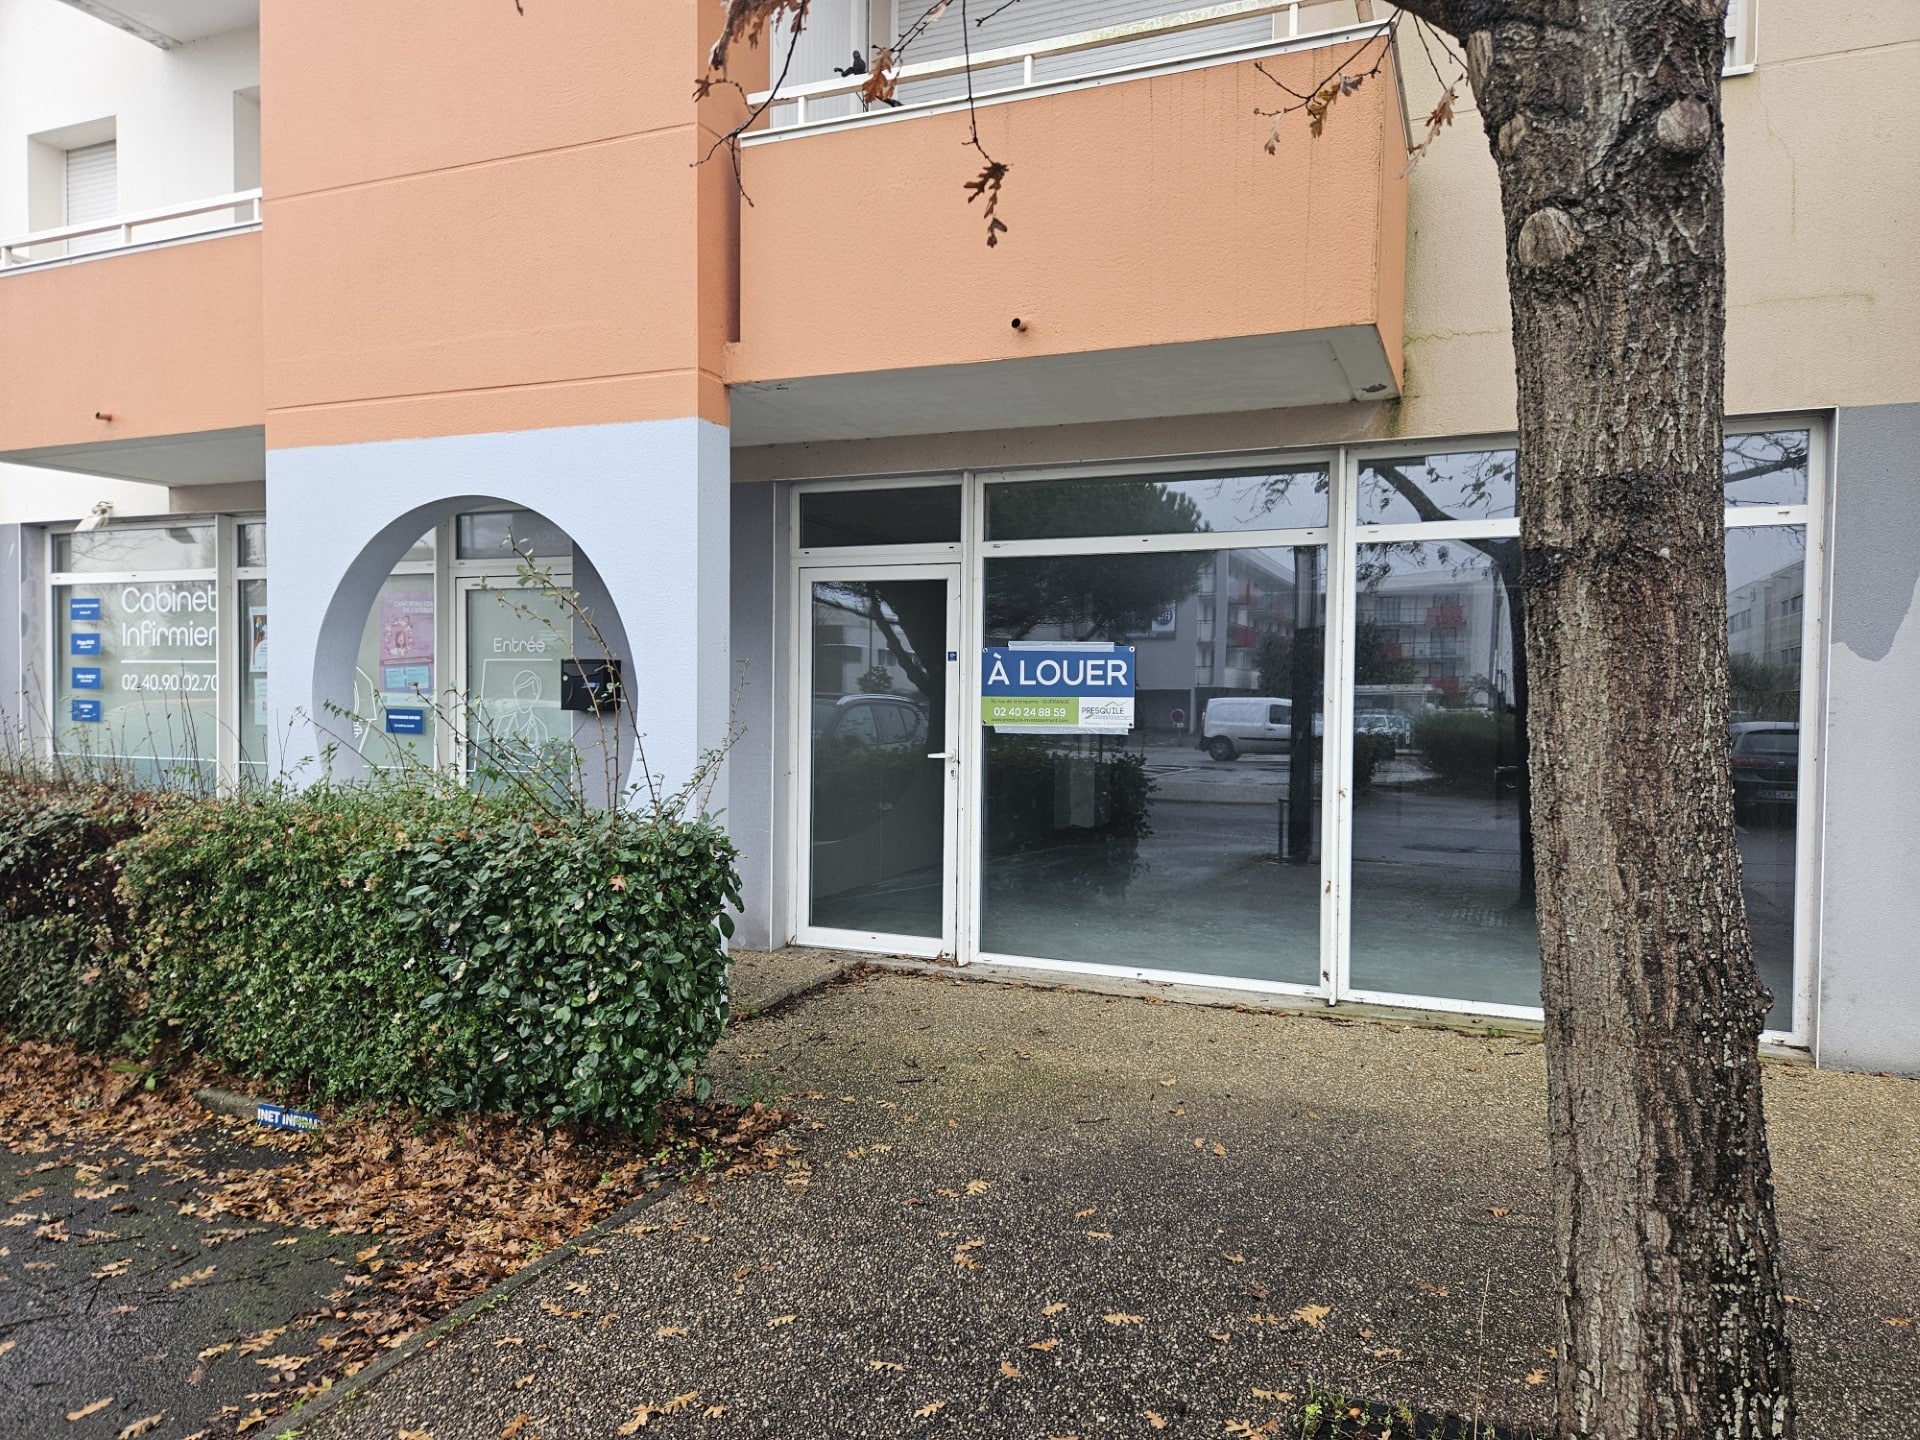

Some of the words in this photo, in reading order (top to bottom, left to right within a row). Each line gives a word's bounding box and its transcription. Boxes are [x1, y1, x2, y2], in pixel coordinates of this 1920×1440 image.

[122, 584, 217, 613] Cabinet
[122, 620, 217, 647] Infirmier
[493, 636, 546, 652] Entrée
[987, 652, 1010, 685] À
[1019, 659, 1128, 686] LOUER
[993, 707, 1006, 717] 02
[1008, 707, 1021, 717] 40
[1023, 707, 1036, 717] 24
[1053, 707, 1066, 717] 59
